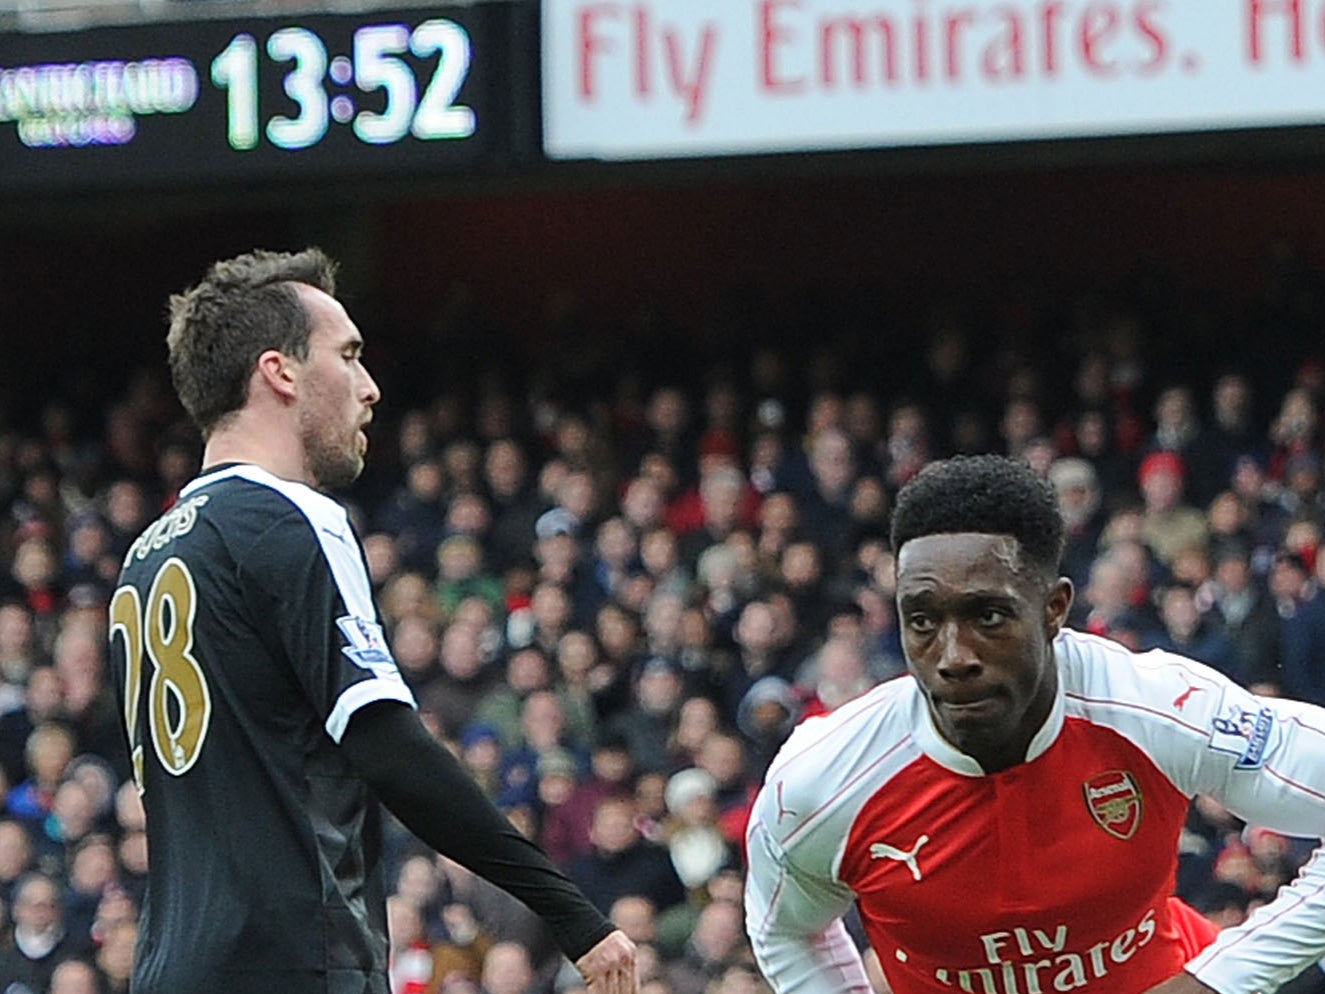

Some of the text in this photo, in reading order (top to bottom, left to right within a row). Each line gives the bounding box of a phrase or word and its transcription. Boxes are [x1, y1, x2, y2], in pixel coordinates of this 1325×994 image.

[211, 18, 477, 151] 13:52
[573, 4, 720, 130] Fly
[757, 0, 1198, 92] Emirates.
[979, 925, 1068, 964] Fly
